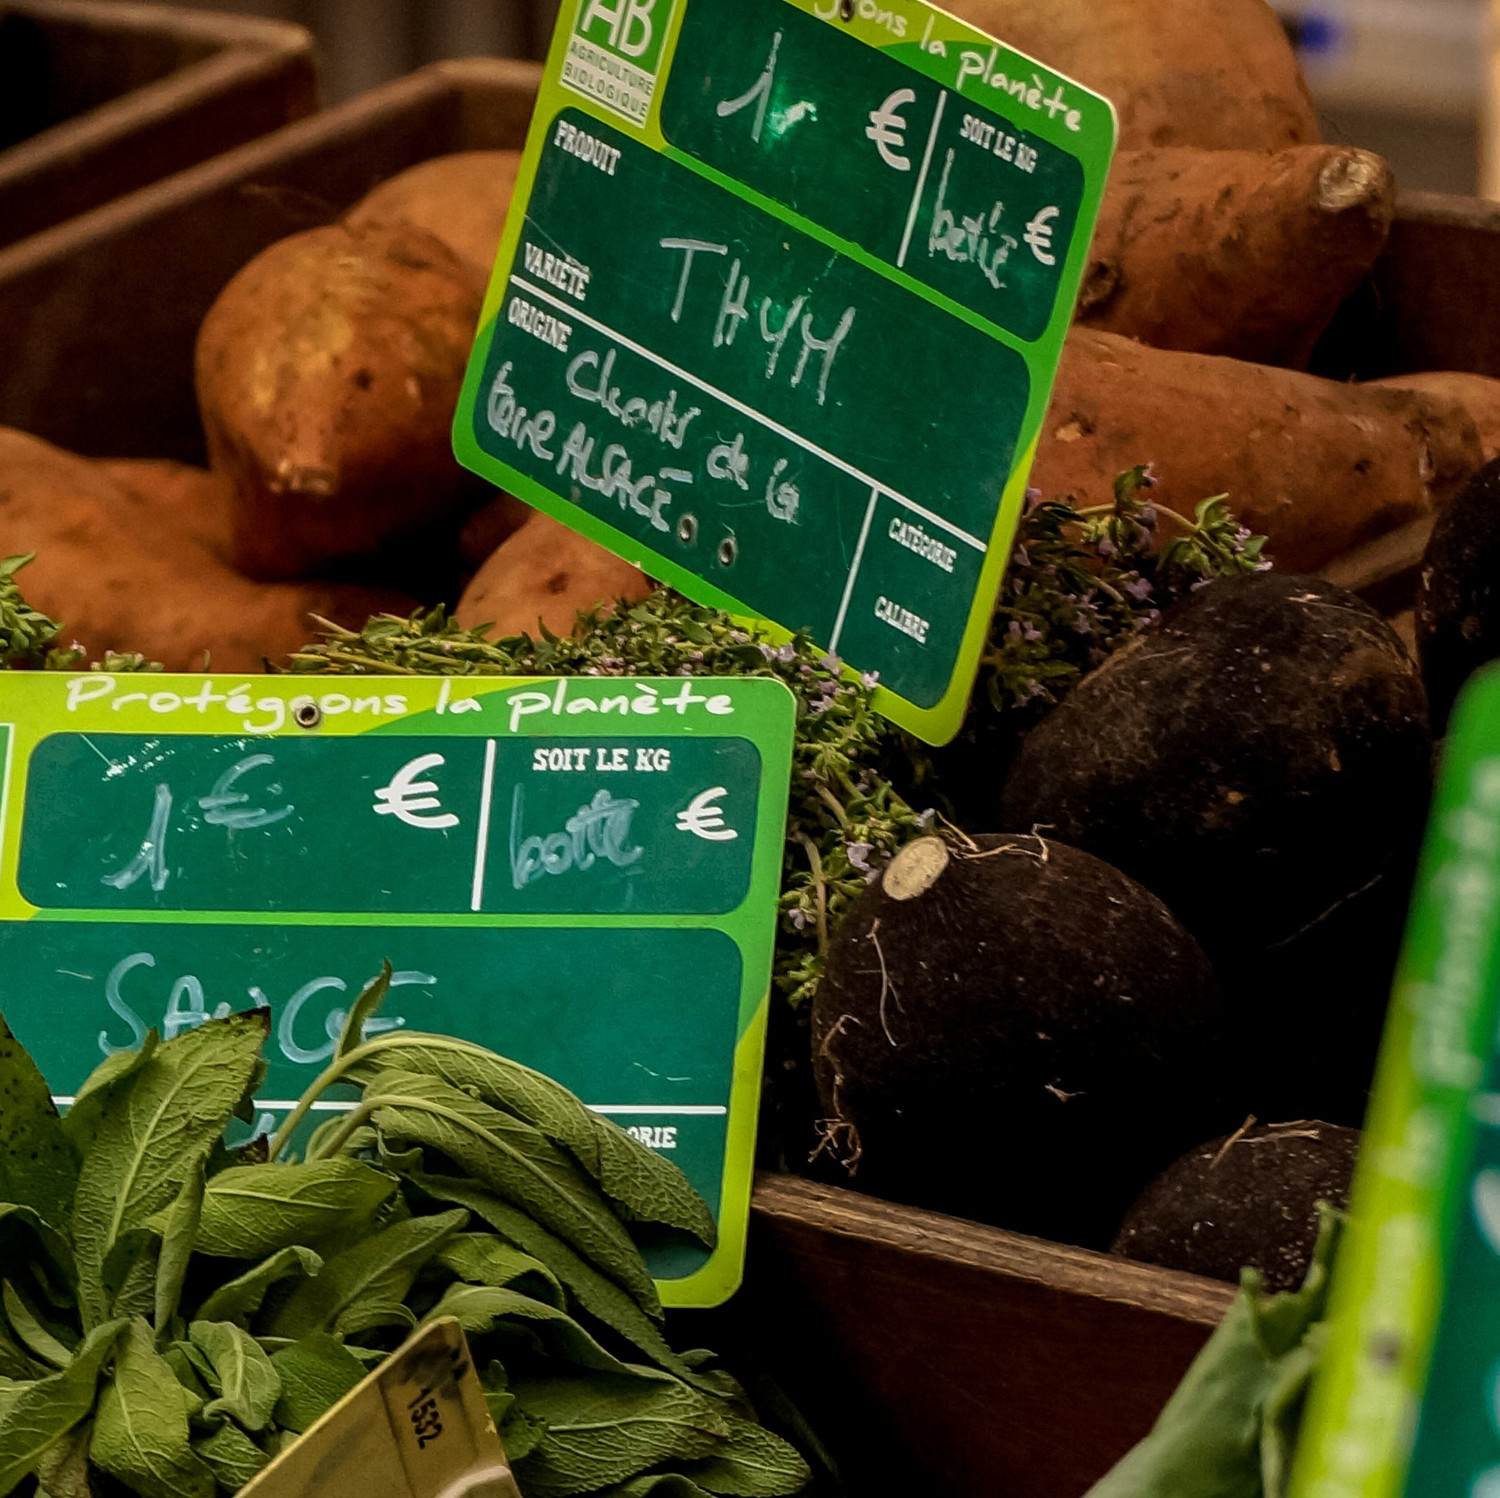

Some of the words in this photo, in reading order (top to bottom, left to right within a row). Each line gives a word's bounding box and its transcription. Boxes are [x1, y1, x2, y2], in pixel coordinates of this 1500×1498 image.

[564, 61, 649, 117] BIOLOGIQUE
[570, 40, 655, 97] AGRICULTURE
[920, 13, 947, 58] la
[956, 44, 1081, 131] planète
[553, 119, 622, 176] PRODUIT
[865, 88, 916, 171] €
[959, 113, 996, 150] SOIT
[992, 130, 1017, 162] LE
[1013, 141, 1038, 174] KG
[1023, 206, 1060, 265] €
[507, 296, 573, 353] ORIGINE
[874, 595, 930, 644] CALIBRE
[436, 679, 483, 715] la
[507, 677, 735, 733] planète
[532, 748, 591, 772] SOIT
[595, 748, 630, 772] LE
[634, 748, 672, 772] KG
[373, 753, 460, 829] €
[675, 786, 738, 841] €
[98, 952, 437, 1063] SAGE
